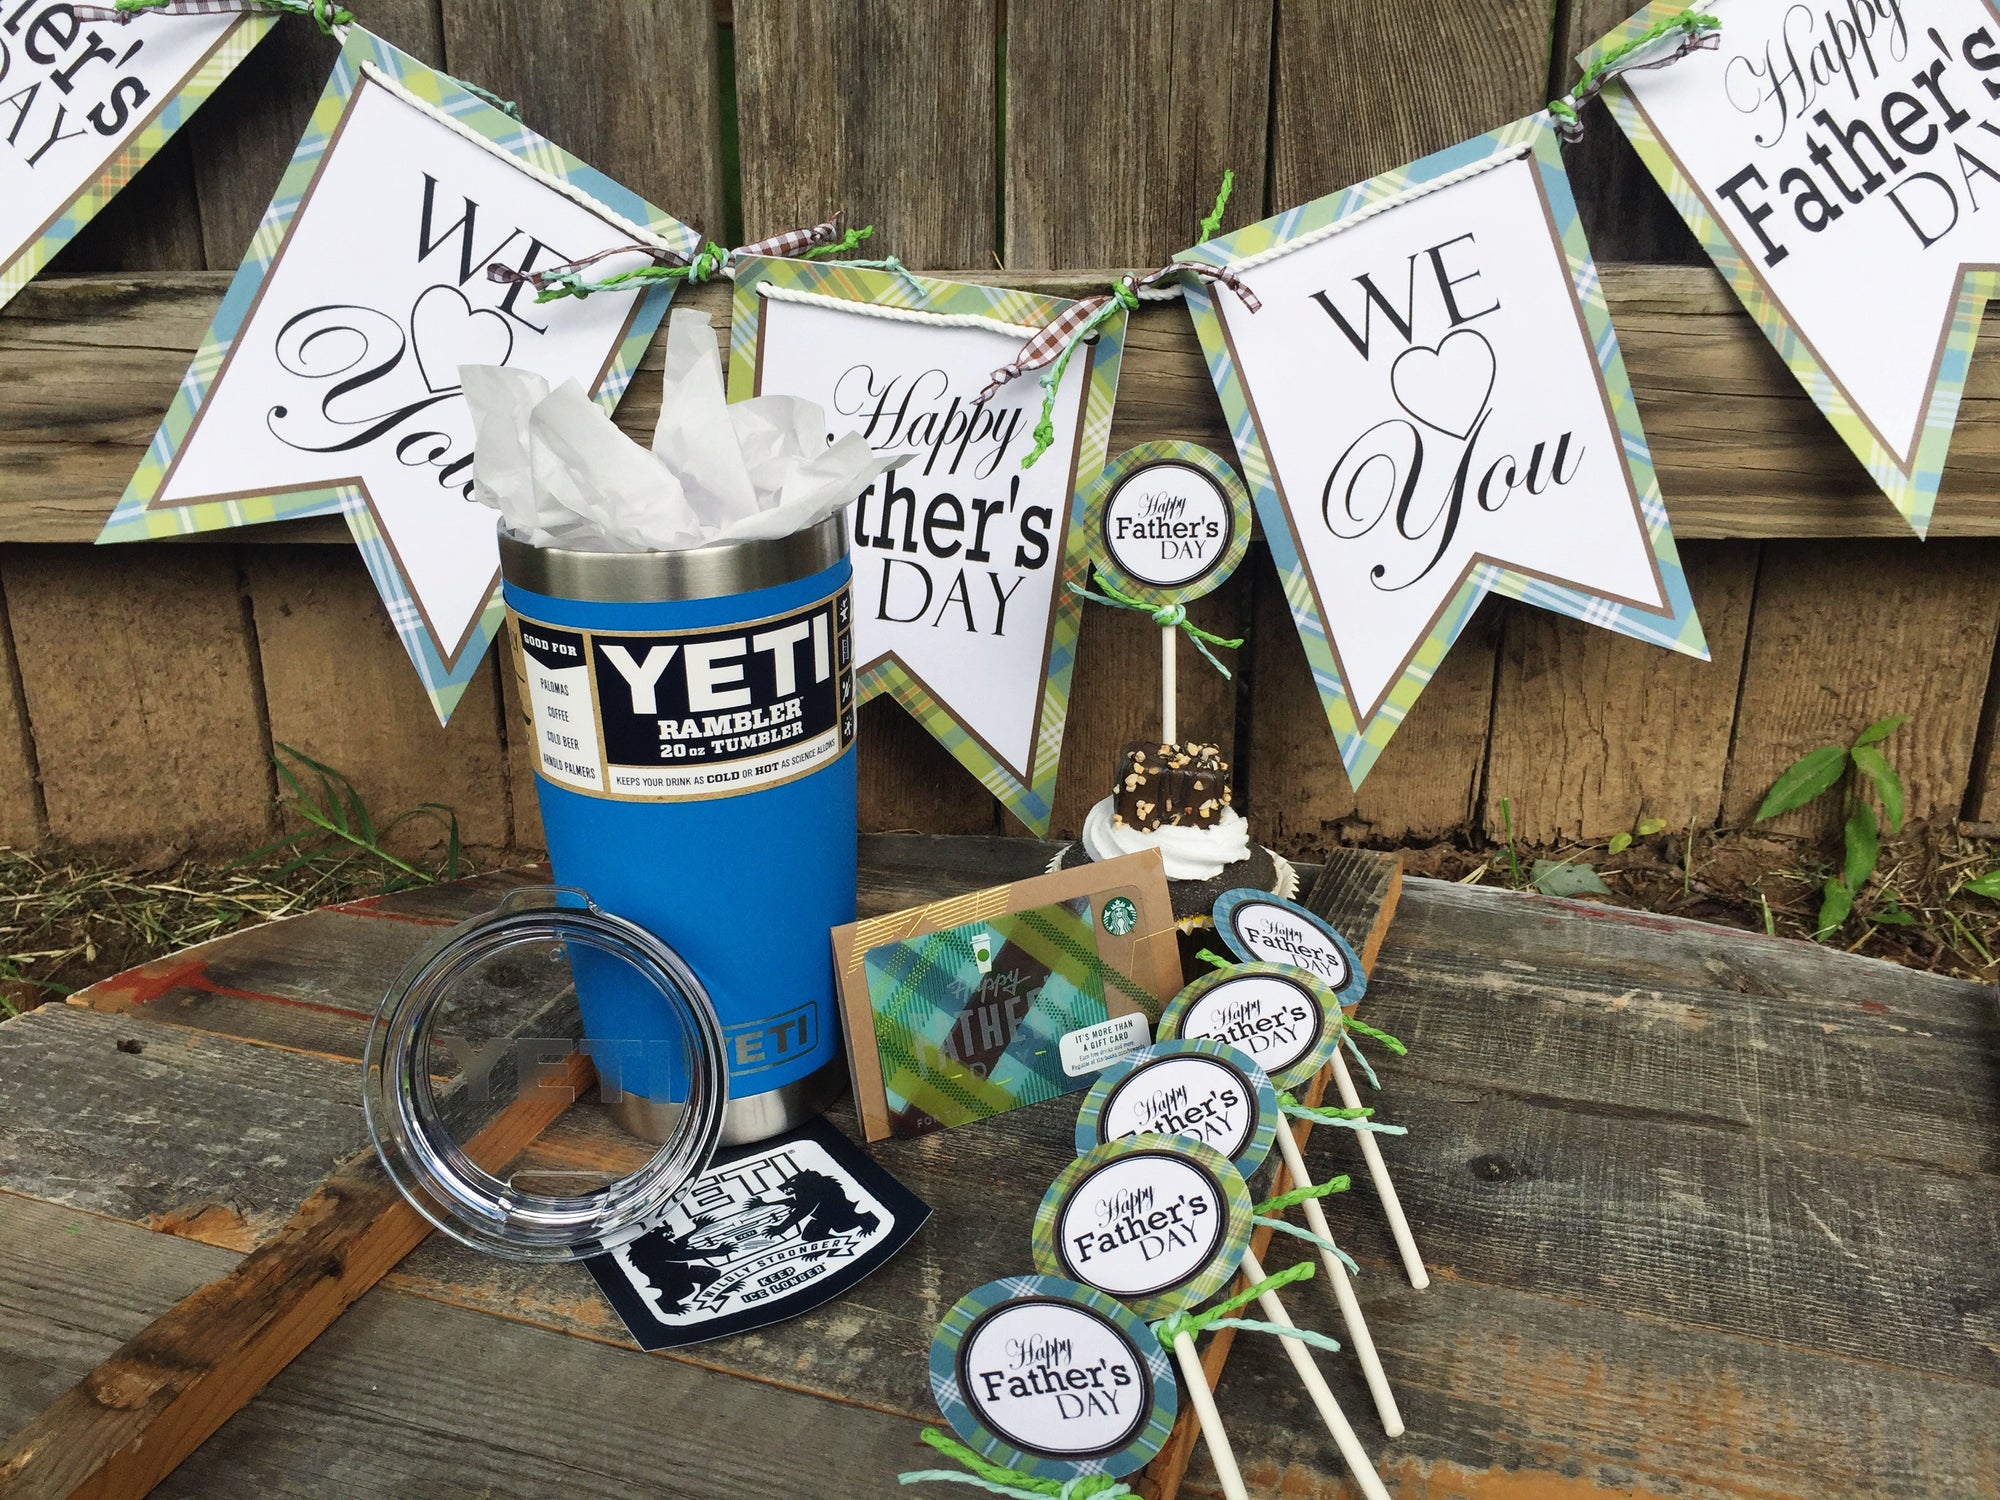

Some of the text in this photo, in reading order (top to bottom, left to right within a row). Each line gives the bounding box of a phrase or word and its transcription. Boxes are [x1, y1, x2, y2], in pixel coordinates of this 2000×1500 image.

[0, 0, 150, 137] er's
[1725, 0, 1908, 148] Happy
[0, 38, 88, 169] AY
[1715, 27, 2000, 268] Father's
[1884, 118, 2000, 251] DA
[418, 171, 576, 335] WE
[1308, 232, 1502, 361] WE
[826, 363, 1028, 481] Happy
[853, 471, 1054, 570] ther's
[1137, 492, 1188, 519] Happy
[1321, 407, 1586, 592] You
[1115, 515, 1219, 540] Father's
[1161, 540, 1207, 560] DAY
[875, 557, 1027, 637] DAY
[523, 632, 550, 653] GOOD
[552, 640, 578, 657] FOR
[599, 612, 831, 715] YETI
[540, 677, 570, 697] PALOMAS
[547, 706, 570, 723] COFFEE
[658, 698, 803, 741] RAMBLER
[546, 729, 580, 751] COLD BEER
[660, 721, 804, 758] 20 oz TUMBLER
[543, 752, 596, 780] ARNOLD PALMERS
[616, 737, 836, 787] KEEPS YOUR DRINK AS COLD OR HOT AS SCIENCE ALLOWS
[1245, 926, 1340, 966] Father's
[1260, 917, 1304, 942] Happy
[1292, 953, 1333, 978] DAY
[1075, 1019, 1133, 1044] IT'S MORE THAN
[1210, 999, 1263, 1031] Happy
[724, 1014, 808, 1065] ETI
[1083, 1031, 1129, 1053] A GIFT CARD
[1249, 1023, 1299, 1054] DAY
[444, 1038, 670, 1104] YETI
[1134, 1085, 1188, 1126] Happy
[666, 1151, 802, 1220] ETI
[1094, 1182, 1156, 1228] Happy
[1073, 1194, 1209, 1263] Father's
[1138, 1220, 1200, 1262] DAY
[702, 1238, 842, 1300] WILDLY STRONGER
[741, 1264, 826, 1304] ICE LONGER
[758, 1266, 796, 1287] KEEP
[1005, 1331, 1075, 1371] Happy
[980, 1357, 1132, 1402] Father's
[1055, 1389, 1123, 1420] DAY
